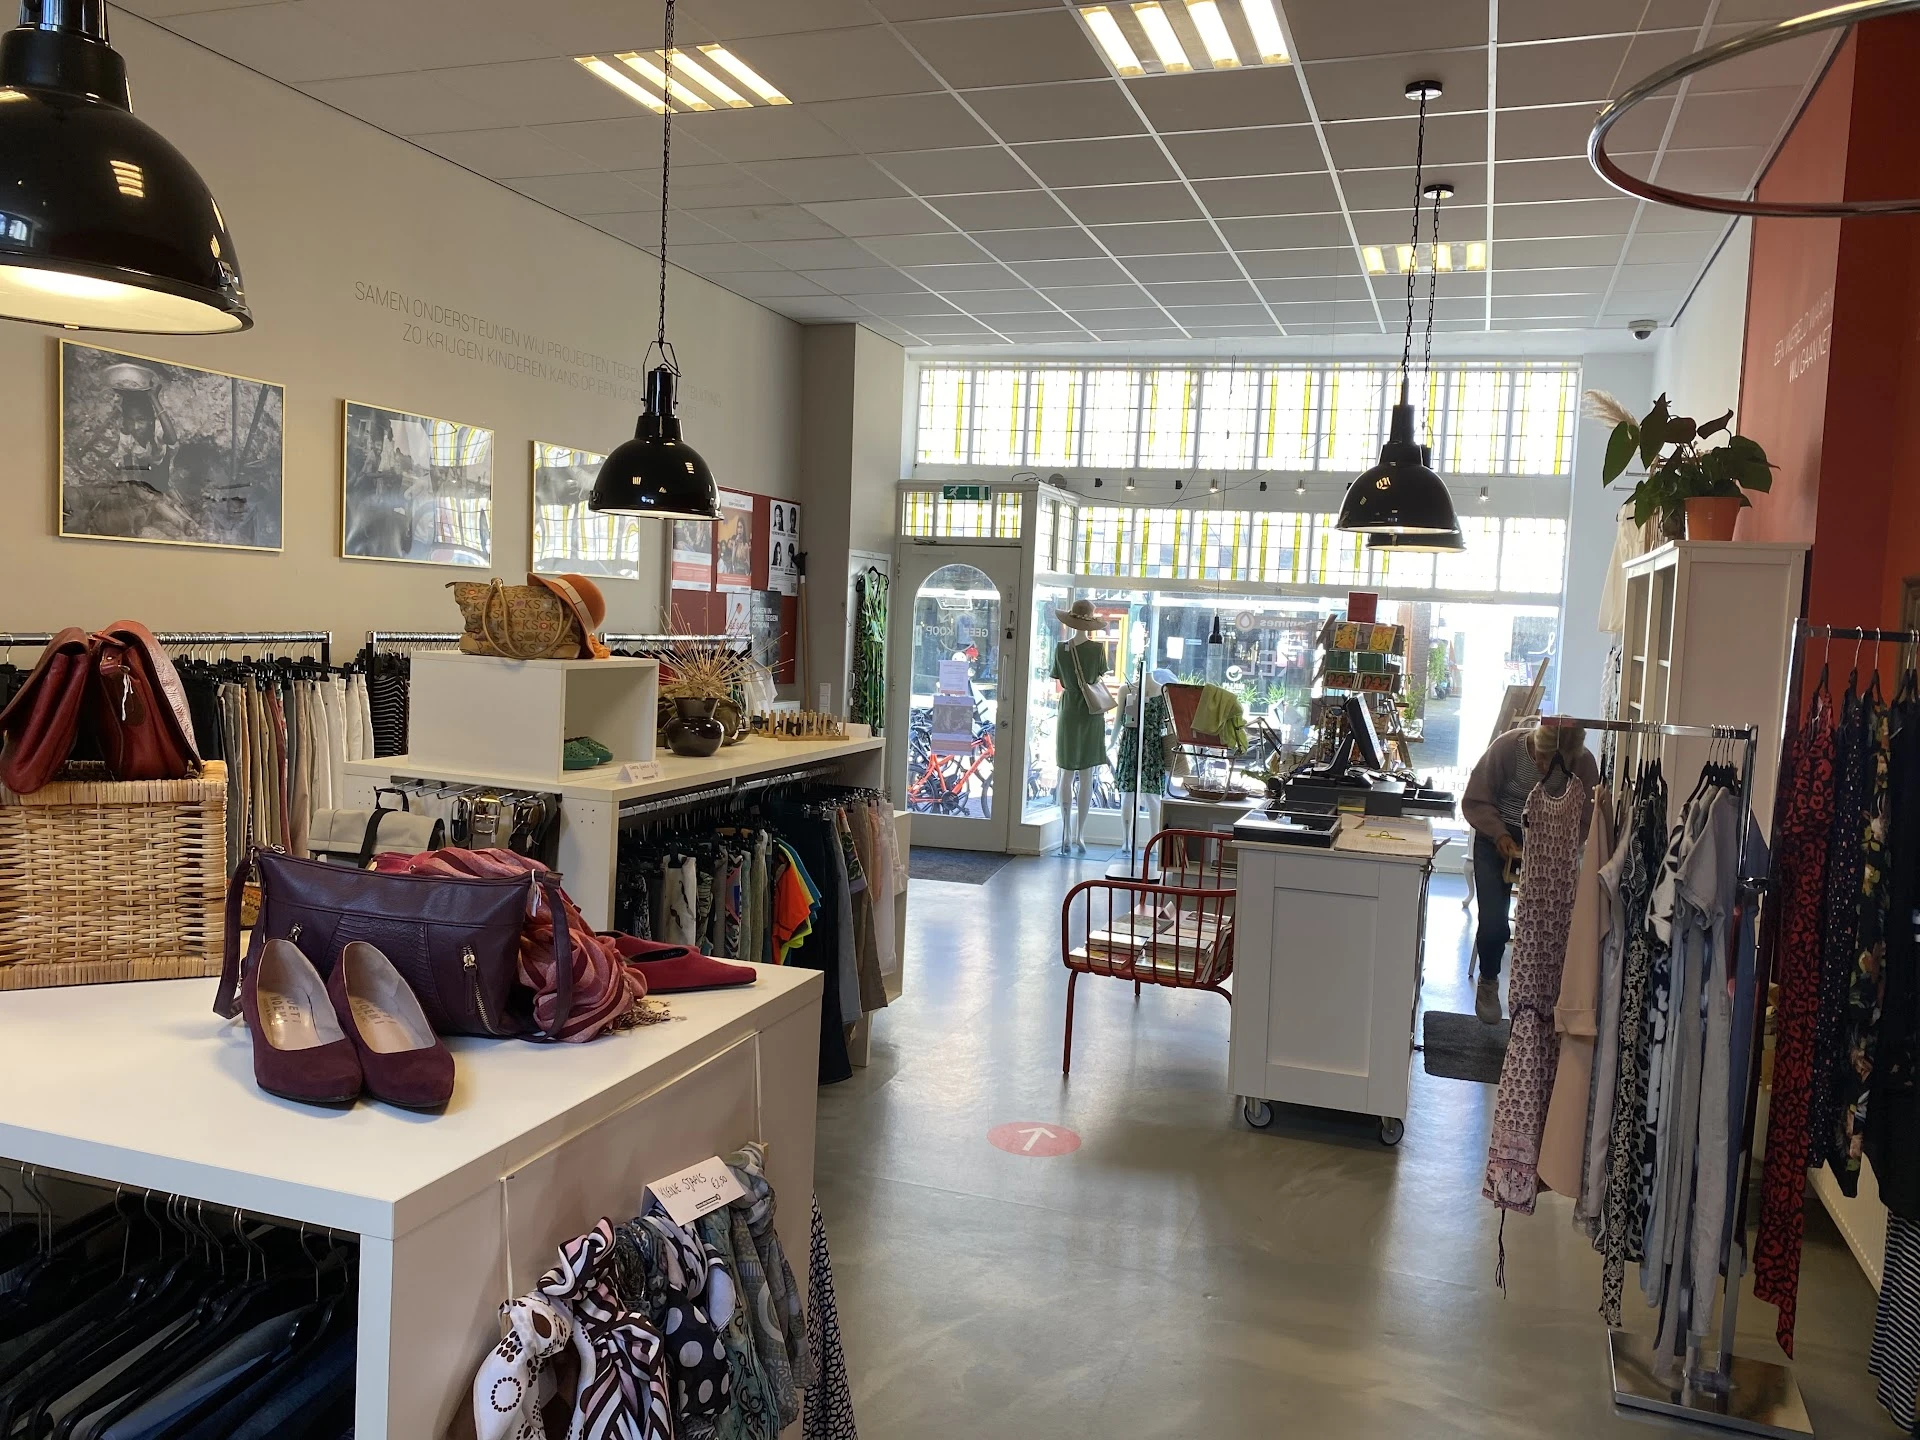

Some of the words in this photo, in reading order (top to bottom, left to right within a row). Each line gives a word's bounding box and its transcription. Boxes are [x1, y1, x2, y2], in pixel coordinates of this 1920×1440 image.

[354, 281, 409, 314] SAMEN
[413, 299, 520, 347] ONDERSTEUNEN
[523, 333, 545, 355] WIJ
[547, 341, 609, 374] PROJECTEN
[611, 360, 643, 383] TEGEN
[402, 322, 422, 345] ZO
[426, 329, 484, 362] KRIJGEN
[487, 347, 547, 379] KINDEREN
[549, 367, 579, 389] KANS
[581, 375, 596, 391] OP
[597, 379, 617, 399] EEN
[765, 614, 779, 622] TEGEN
[658, 1182, 682, 1199] KLEINE
[710, 1175, 728, 1190] €2,50
